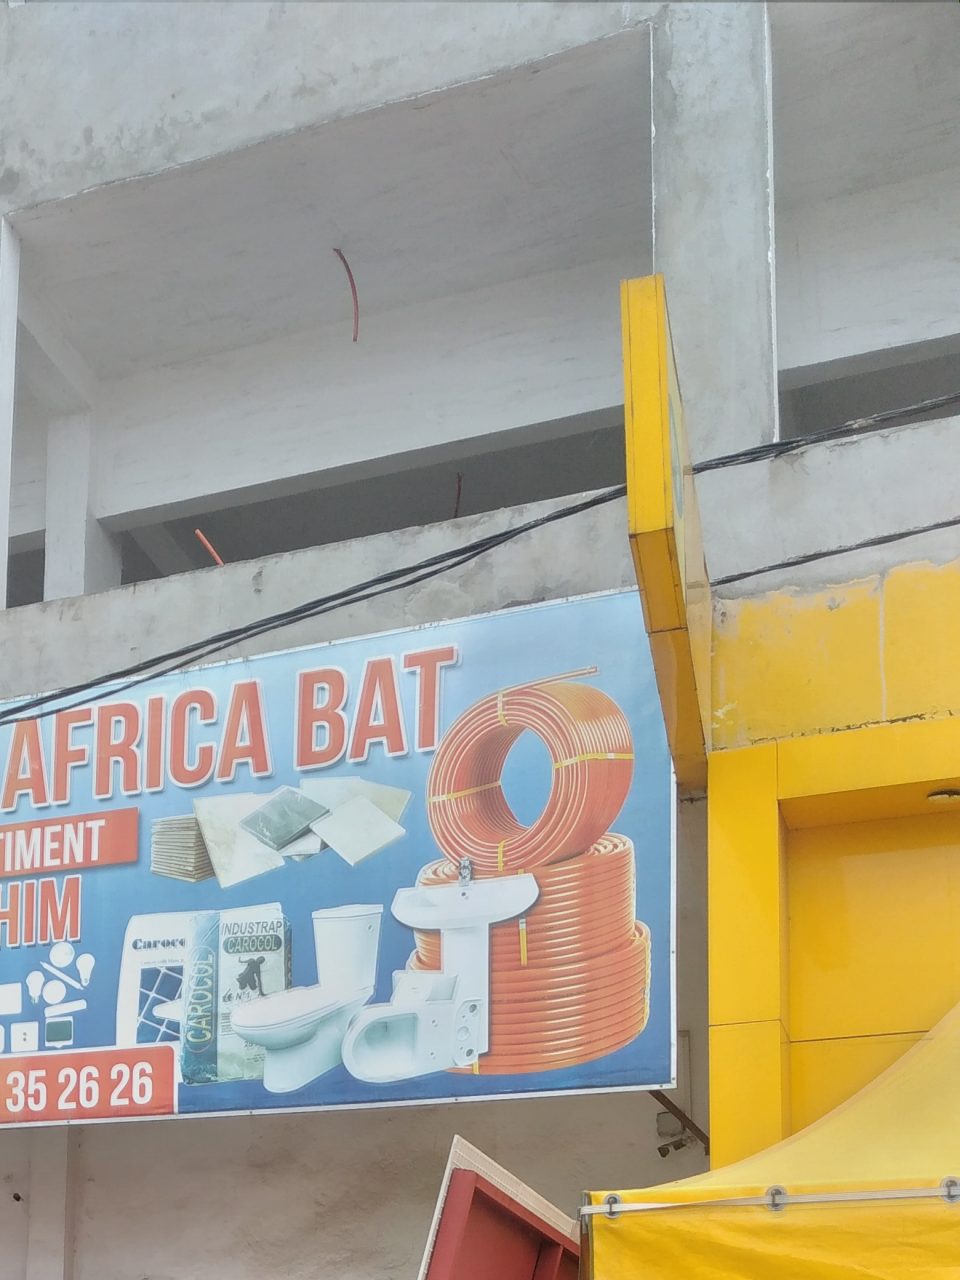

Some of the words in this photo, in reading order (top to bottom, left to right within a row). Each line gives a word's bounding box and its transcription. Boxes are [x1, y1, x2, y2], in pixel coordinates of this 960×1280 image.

[0, 680, 272, 812] AFRICA
[294, 644, 462, 771] BAT
[222, 920, 283, 936] INDUSTRAP
[226, 935, 278, 953] CAROCOL
[186, 953, 214, 1044] CAROCOL
[6, 1069, 47, 1113] 35
[57, 1065, 100, 1111] 26
[110, 1061, 153, 1106] 26
